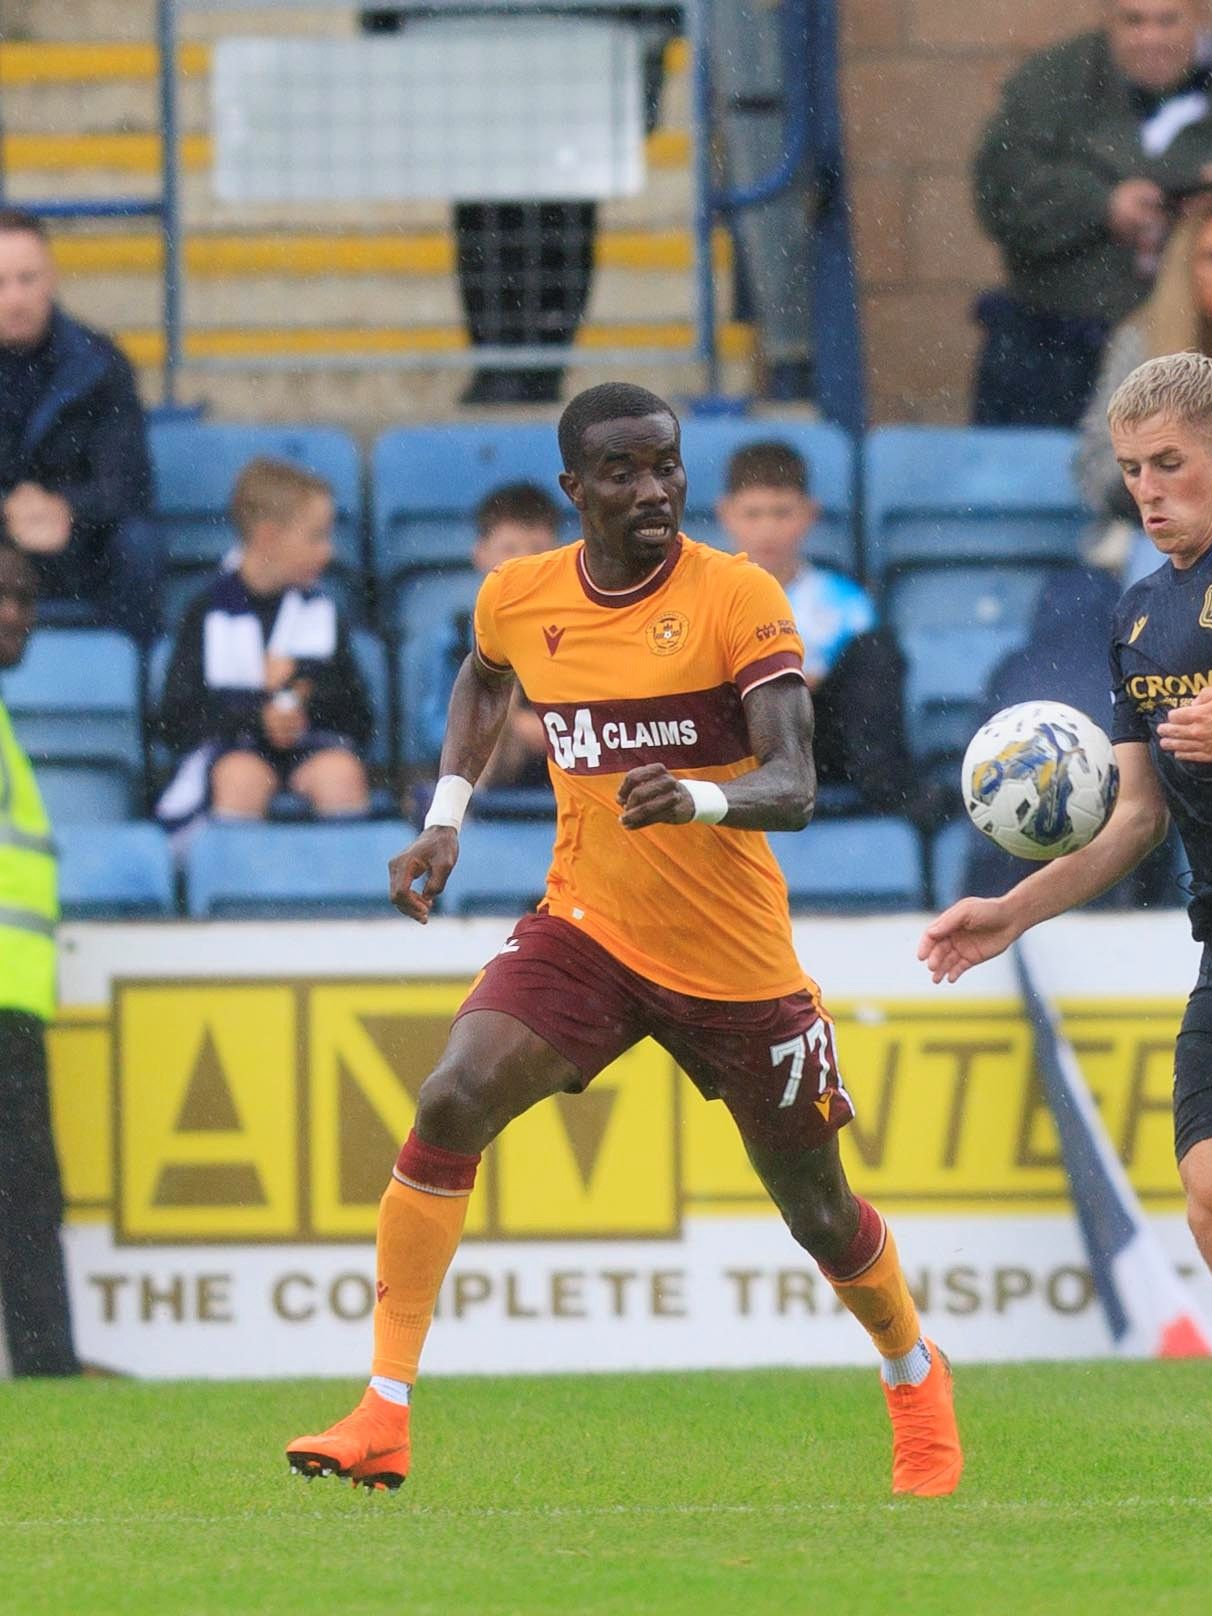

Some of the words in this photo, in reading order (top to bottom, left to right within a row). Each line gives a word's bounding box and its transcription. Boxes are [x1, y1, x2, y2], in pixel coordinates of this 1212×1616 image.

[543, 708, 602, 769] G4
[602, 719, 699, 750] CLAIMS
[87, 1271, 235, 1324] THE
[271, 1270, 690, 1323] COPLETE
